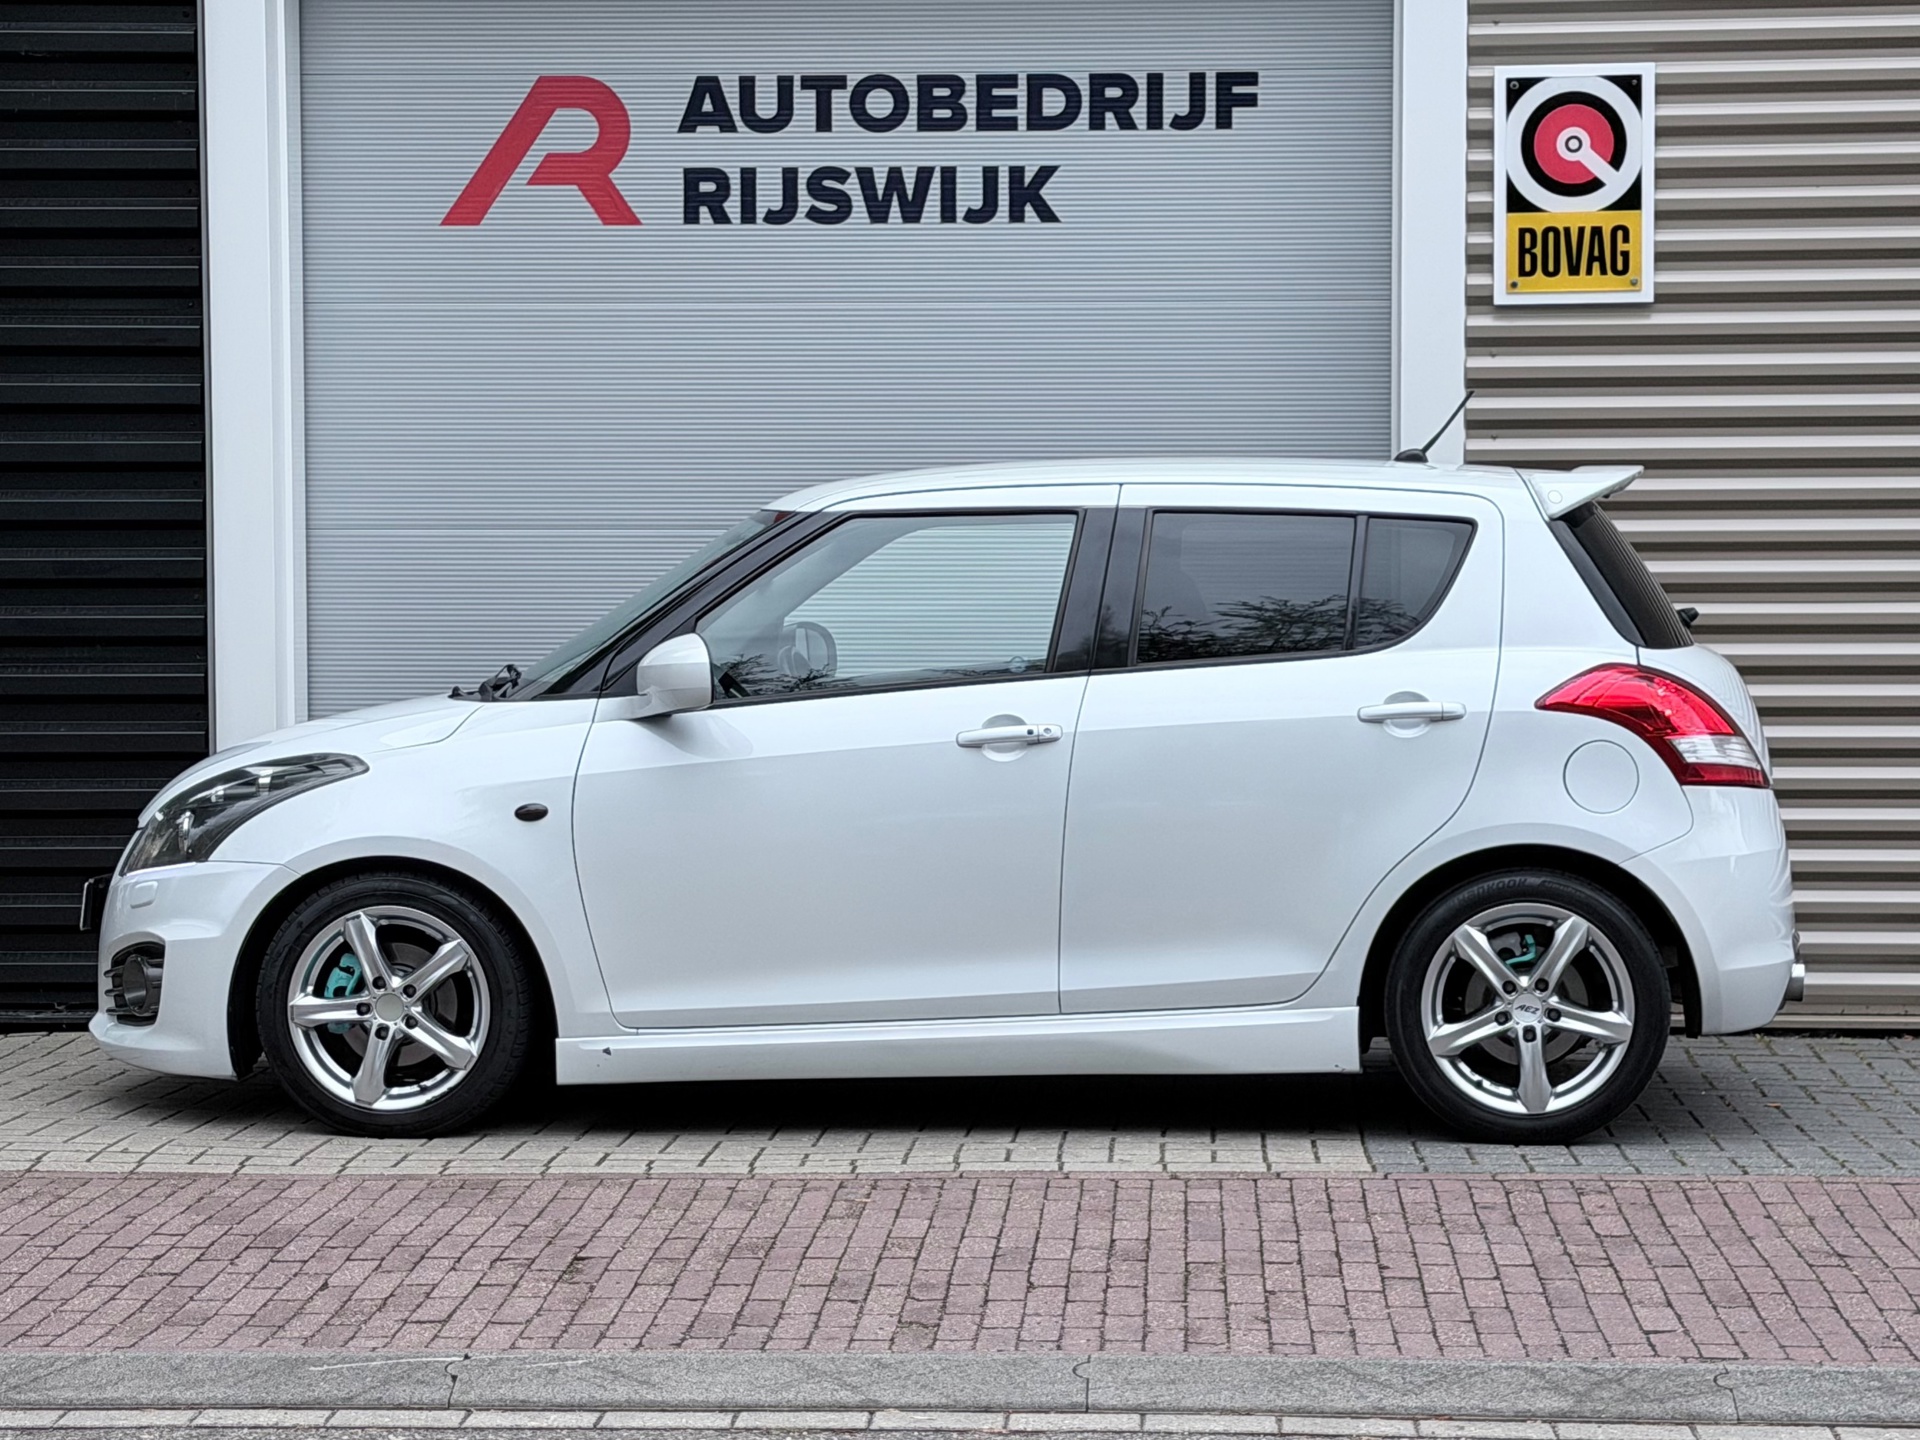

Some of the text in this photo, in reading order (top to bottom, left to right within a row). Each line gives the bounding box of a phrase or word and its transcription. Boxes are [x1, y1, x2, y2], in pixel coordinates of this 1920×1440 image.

[677, 71, 1259, 134] AUTOBEDRIJF
[682, 165, 1062, 226] RIJSWIJK
[1517, 224, 1631, 278] BOVAG
[1514, 1003, 1540, 1015] AEZ
